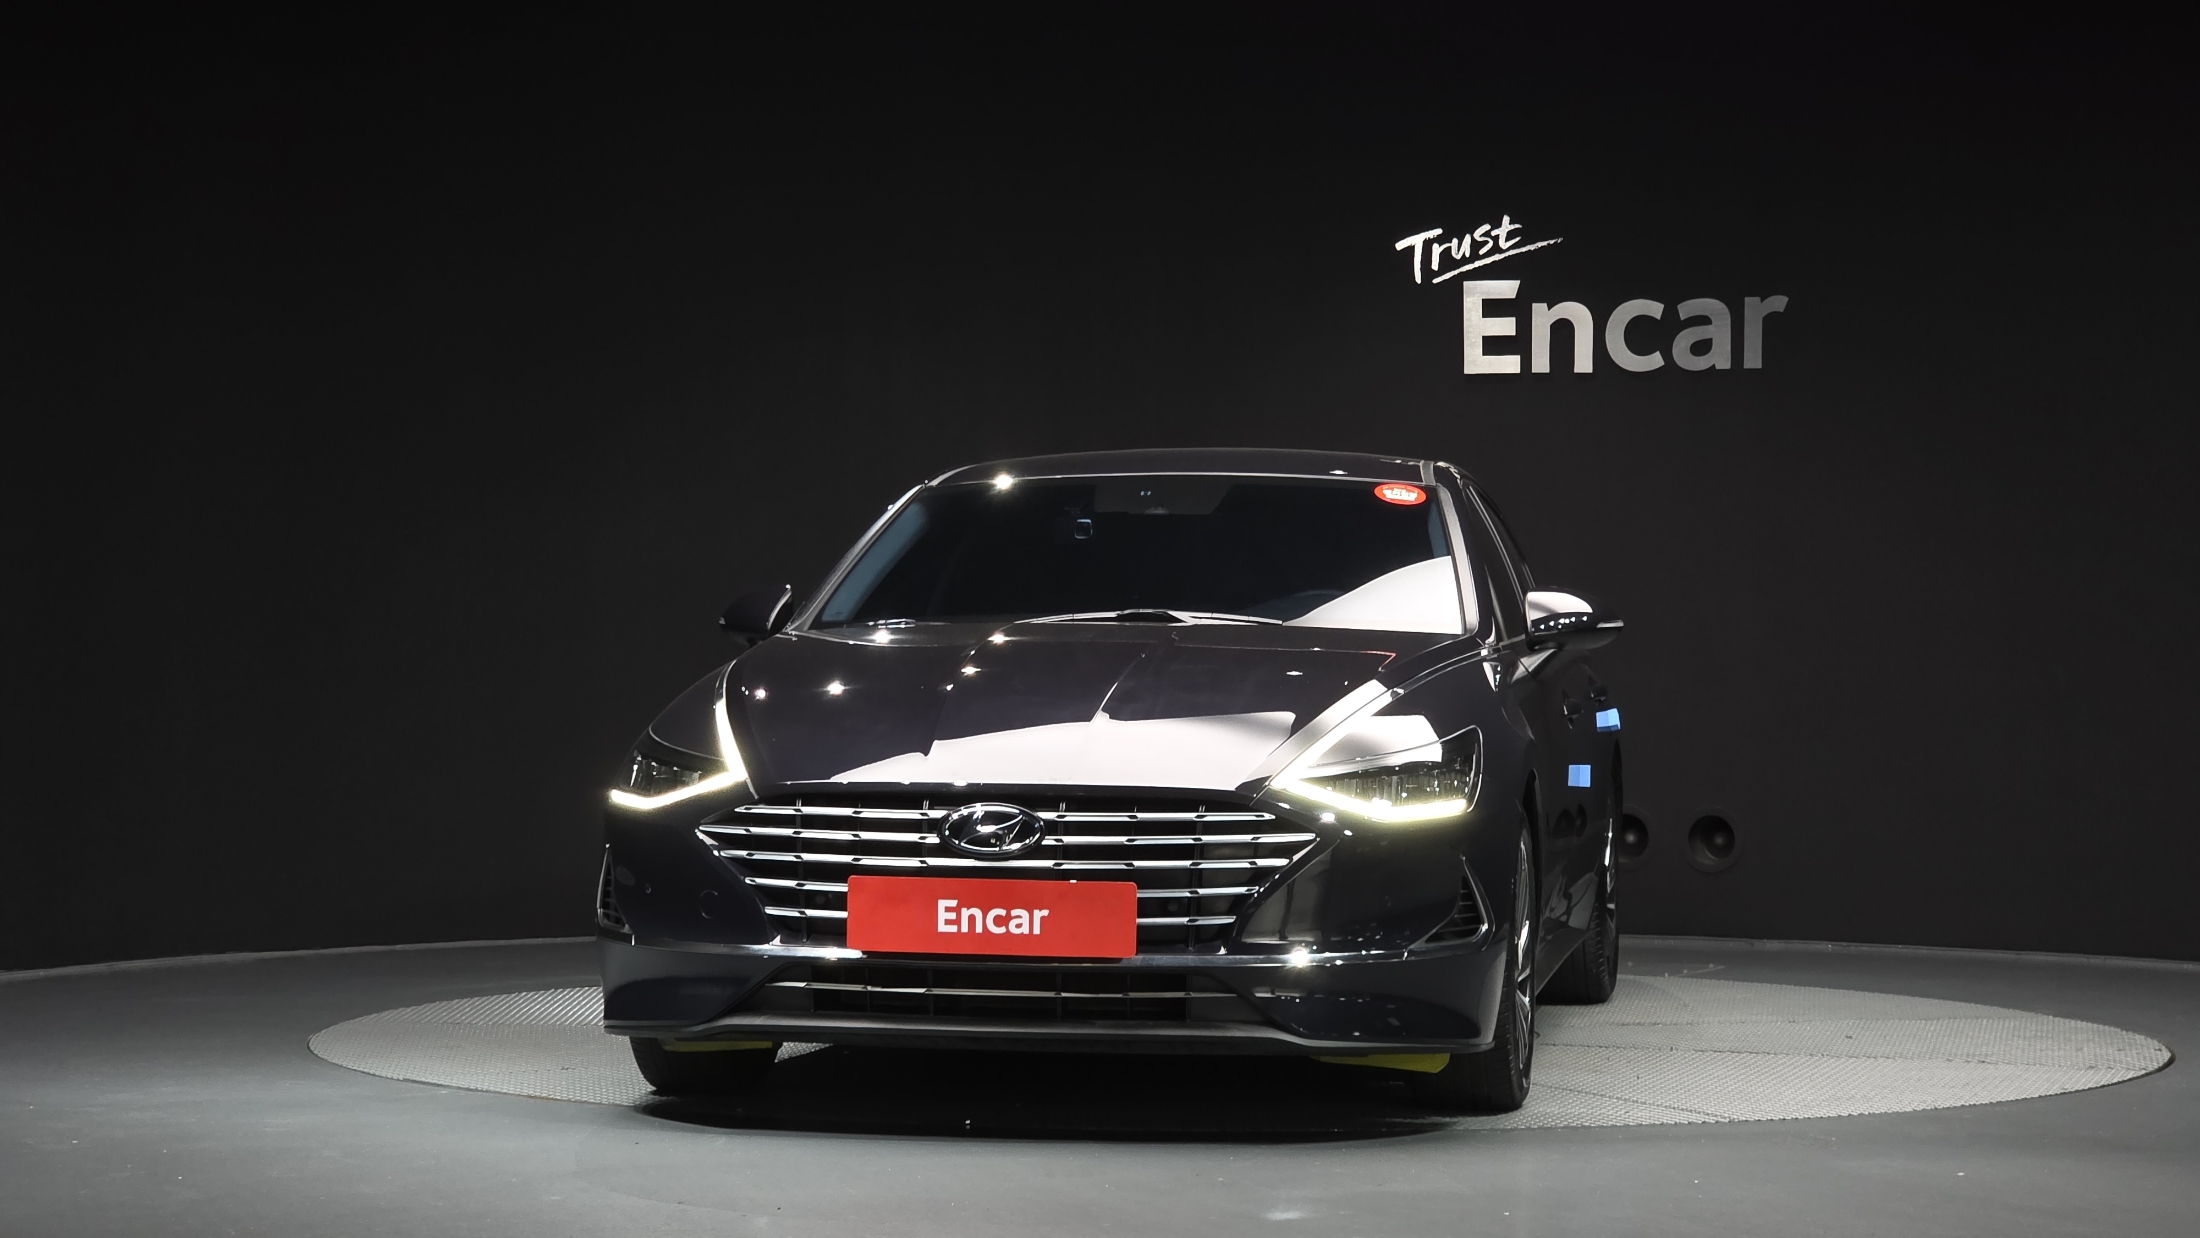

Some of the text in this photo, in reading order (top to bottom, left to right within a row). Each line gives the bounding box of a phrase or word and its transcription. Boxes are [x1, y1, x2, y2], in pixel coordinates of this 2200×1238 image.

[1395, 214, 1523, 284] Trust
[1463, 280, 1789, 375] Encar
[937, 899, 1049, 935] Encar
